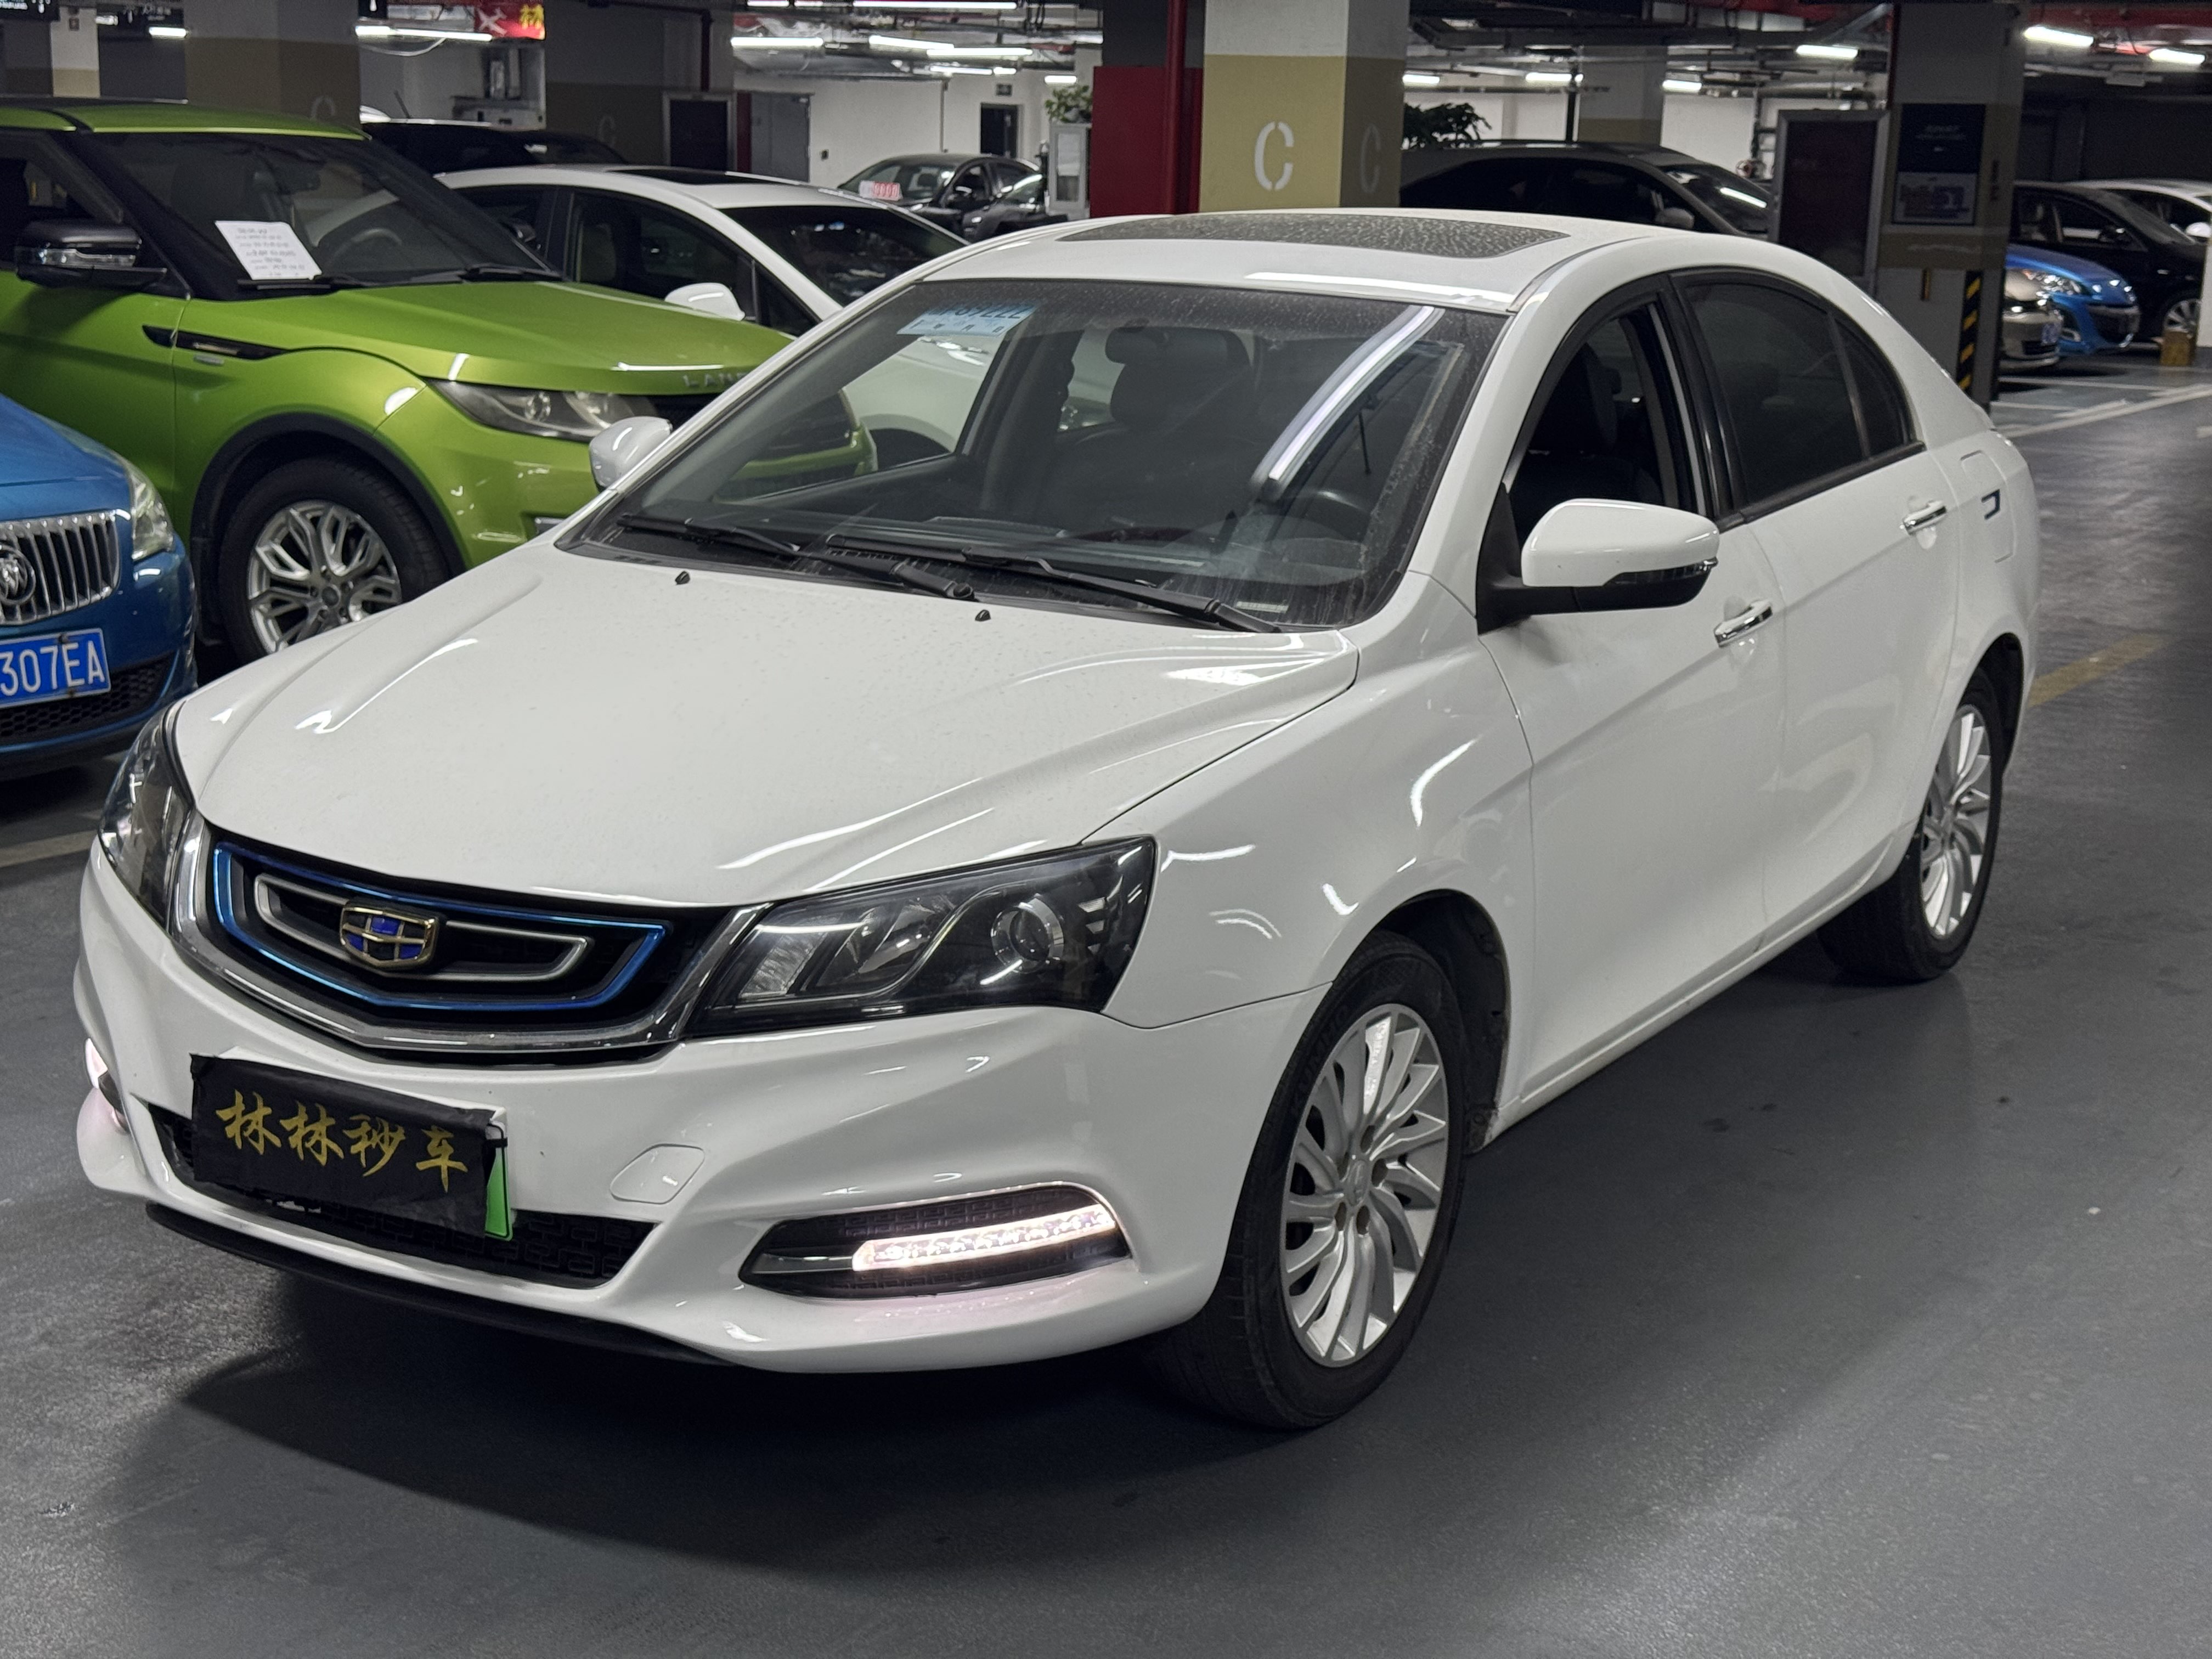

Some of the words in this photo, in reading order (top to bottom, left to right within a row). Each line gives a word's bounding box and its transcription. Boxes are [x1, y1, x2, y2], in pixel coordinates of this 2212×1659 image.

[1255, 121, 1294, 190] C
[1360, 123, 1381, 193] C
[0, 640, 105, 696] 307EA
